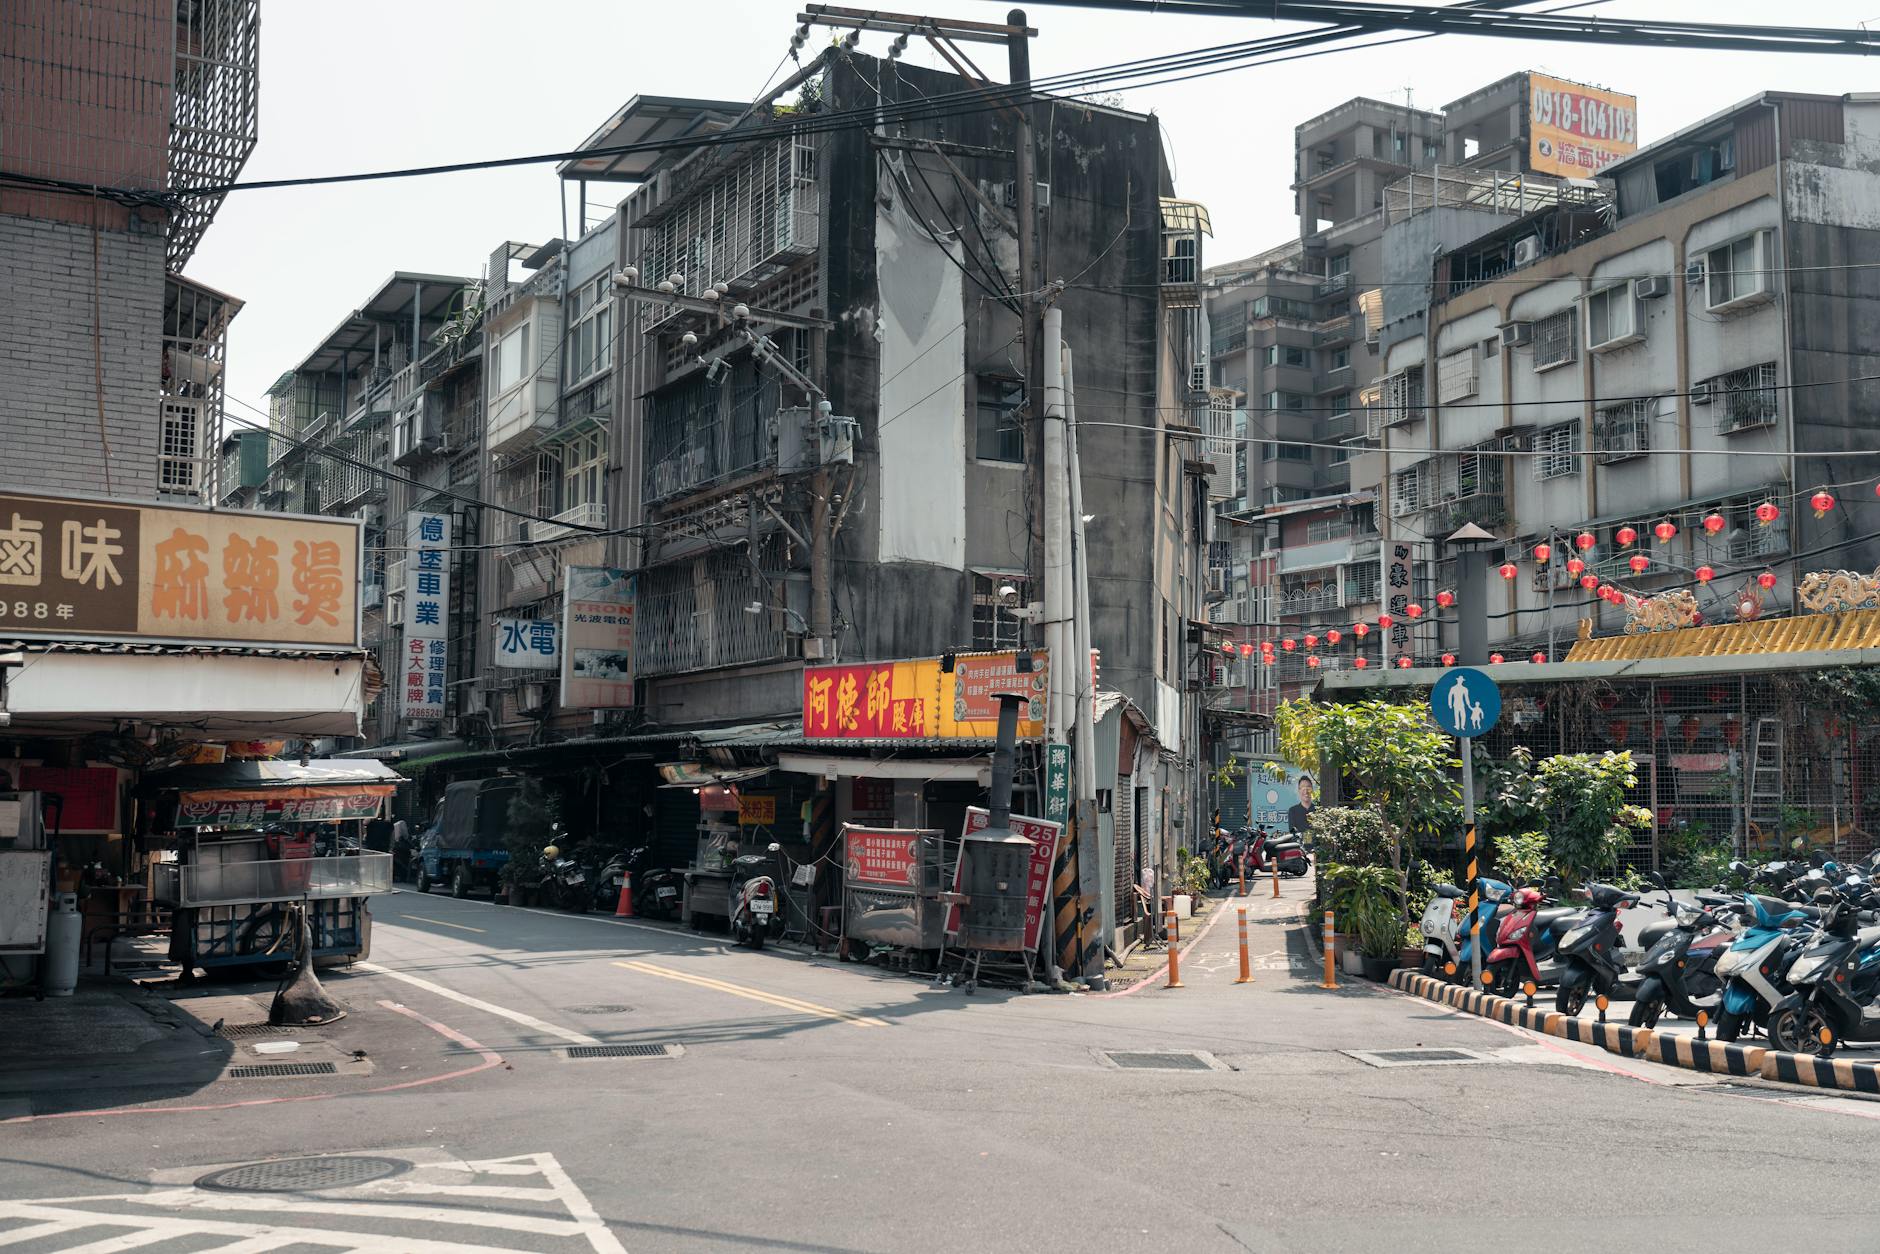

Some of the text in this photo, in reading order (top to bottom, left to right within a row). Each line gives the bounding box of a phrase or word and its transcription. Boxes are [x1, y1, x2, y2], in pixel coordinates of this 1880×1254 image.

[1534, 86, 1634, 144] 0918-104103
[502, 620, 556, 656] 水電
[808, 669, 890, 731] 阿德師
[1048, 749, 1066, 815] 聯華街
[1029, 825, 1053, 841] 25
